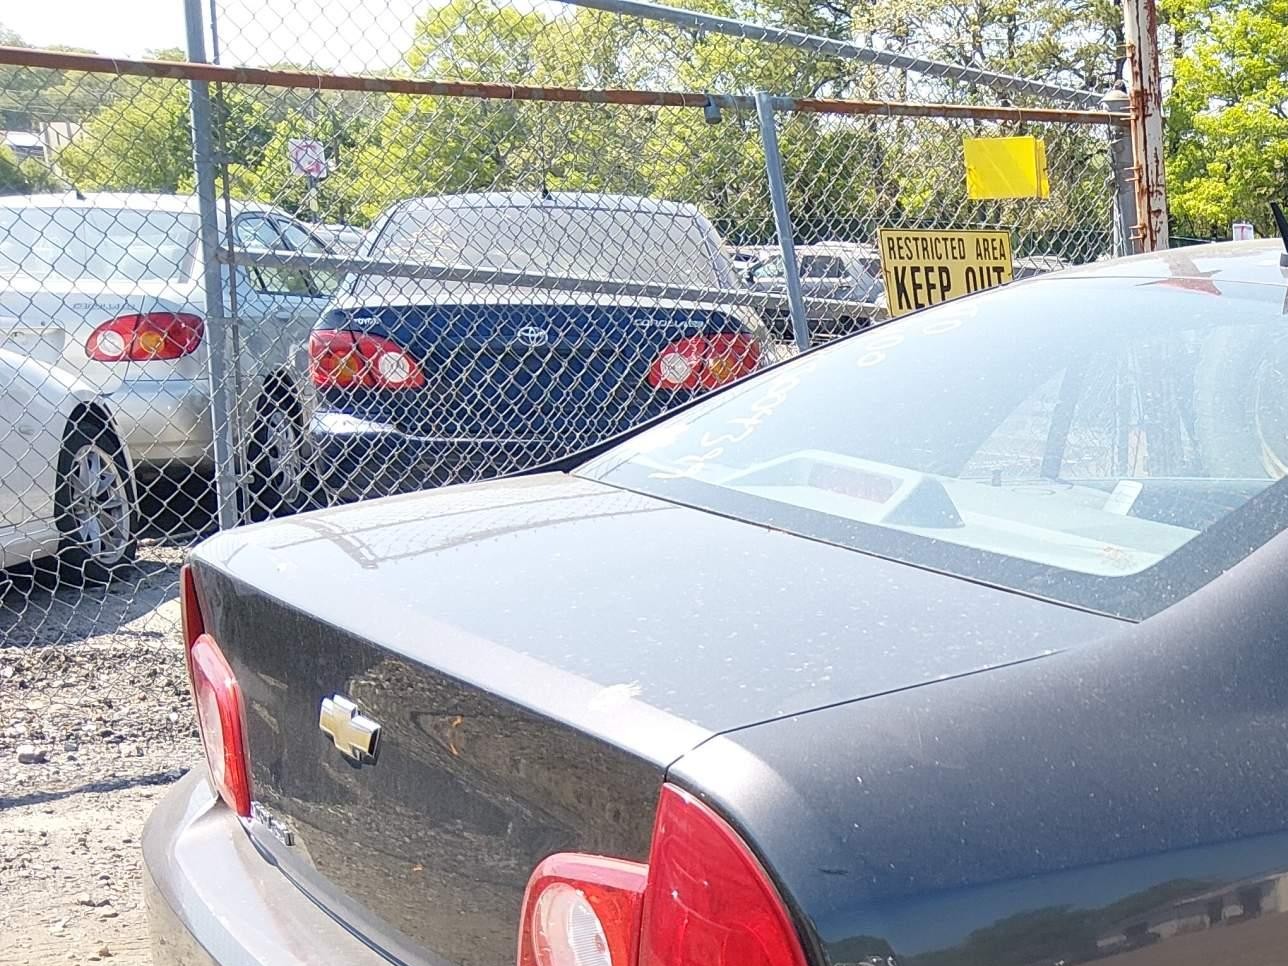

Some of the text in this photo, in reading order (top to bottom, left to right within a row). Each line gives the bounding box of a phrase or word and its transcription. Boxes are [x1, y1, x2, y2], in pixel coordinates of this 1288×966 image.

[886, 236, 1007, 261] RESTRICTED AREA
[893, 266, 952, 310] KEEP
